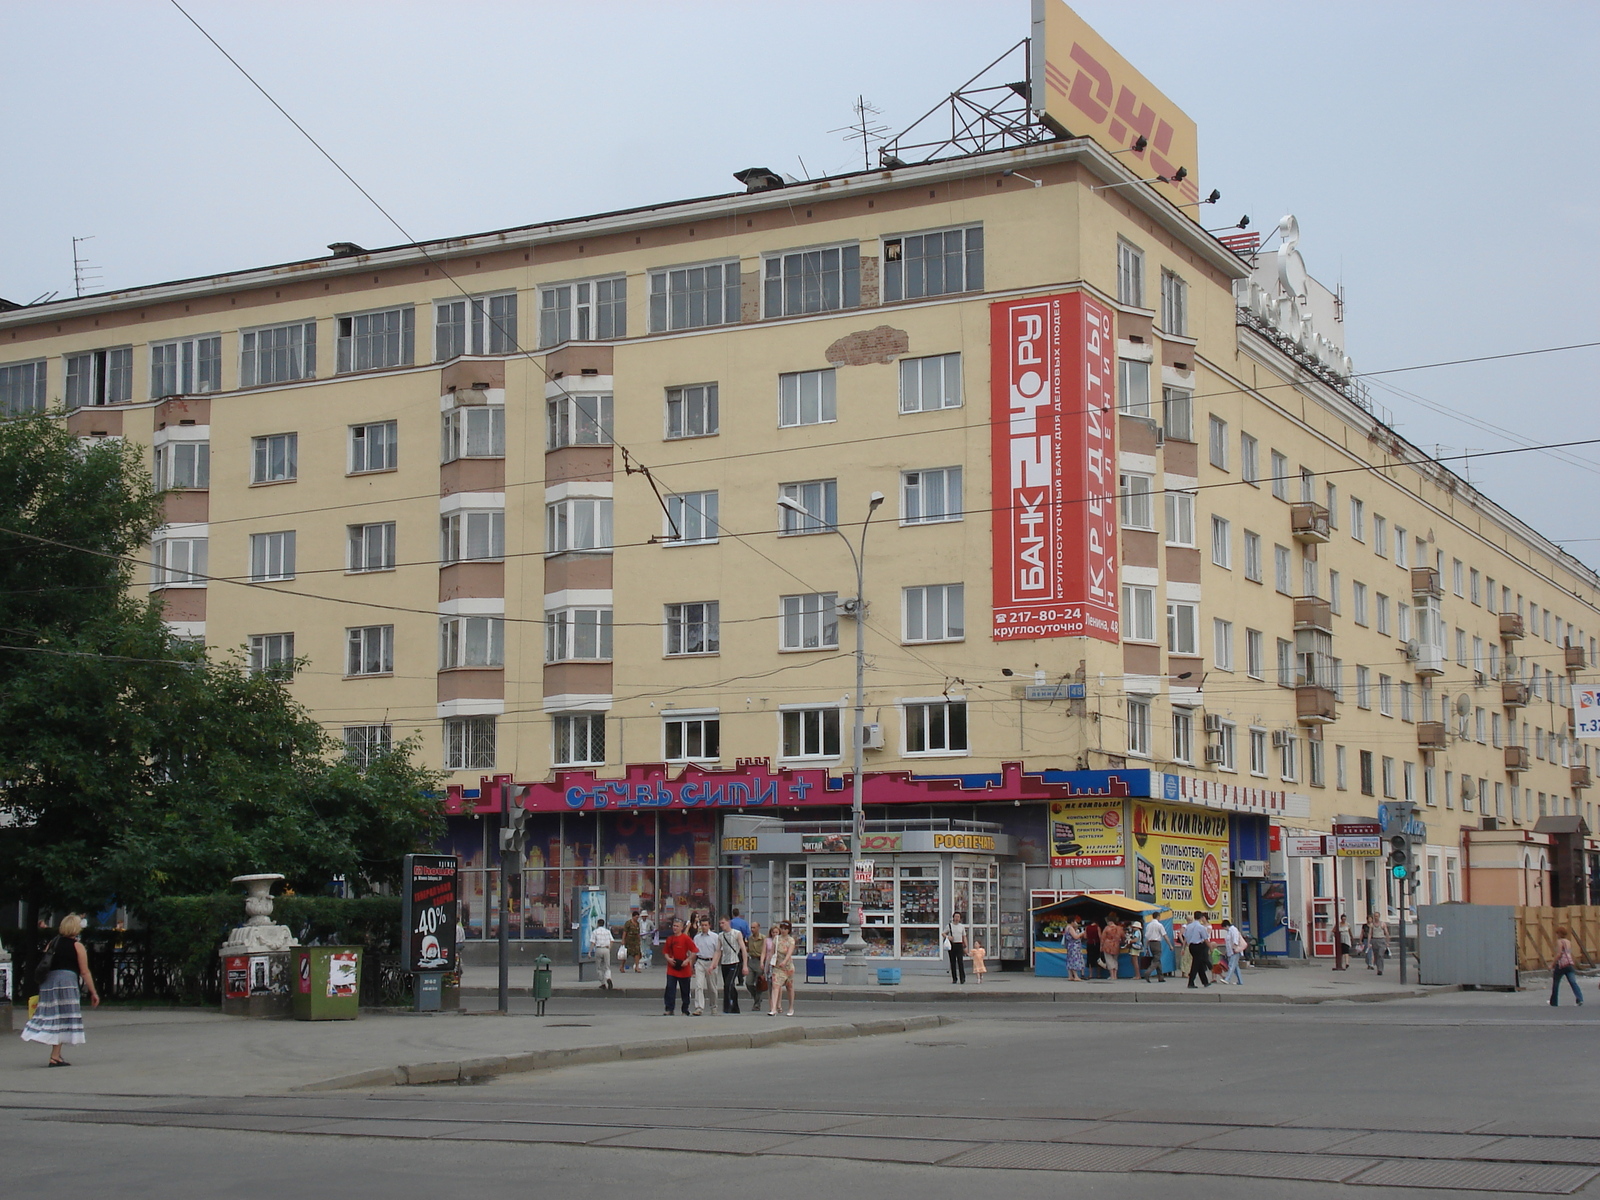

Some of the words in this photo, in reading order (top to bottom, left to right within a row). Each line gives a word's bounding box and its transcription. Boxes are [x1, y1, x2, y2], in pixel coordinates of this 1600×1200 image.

[1068, 41, 1180, 187] DHL
[1053, 299, 1061, 345] ЛЮДЕЙ
[1054, 348, 1062, 411] ДЕЛОВЫХ
[1087, 312, 1104, 597] КРЕДИТЫ
[1103, 314, 1114, 608] НАСЕЛЕНИЮ
[1055, 479, 1064, 599] КРУГЛОСУТОЧНЫЙ
[1010, 608, 1081, 623] 217-80-24
[1085, 612, 1109, 632] Ленина,
[1110, 620, 1119, 633] 48
[994, 622, 1083, 637] круглосуточно
[1071, 687, 1083, 695] 48
[565, 780, 673, 808] ОБУВЬ
[1181, 776, 1286, 810] ЦЕНТРАЛЬНЫЙ
[1153, 809, 1168, 832] МК
[1171, 811, 1226, 837] КОМПЬЮТЕР
[861, 836, 900, 849] JOY
[934, 834, 995, 850] РОСПЕЧАТЬ
[1161, 844, 1205, 859] КОМПЬЮТЕРЫ
[1065, 858, 1092, 866] МЕТРОВ
[1161, 858, 1195, 872] МОНИТОРЫ
[1161, 873, 1194, 887] ПРИНТЕРЫ
[1161, 888, 1192, 900] НОУТБУКИ
